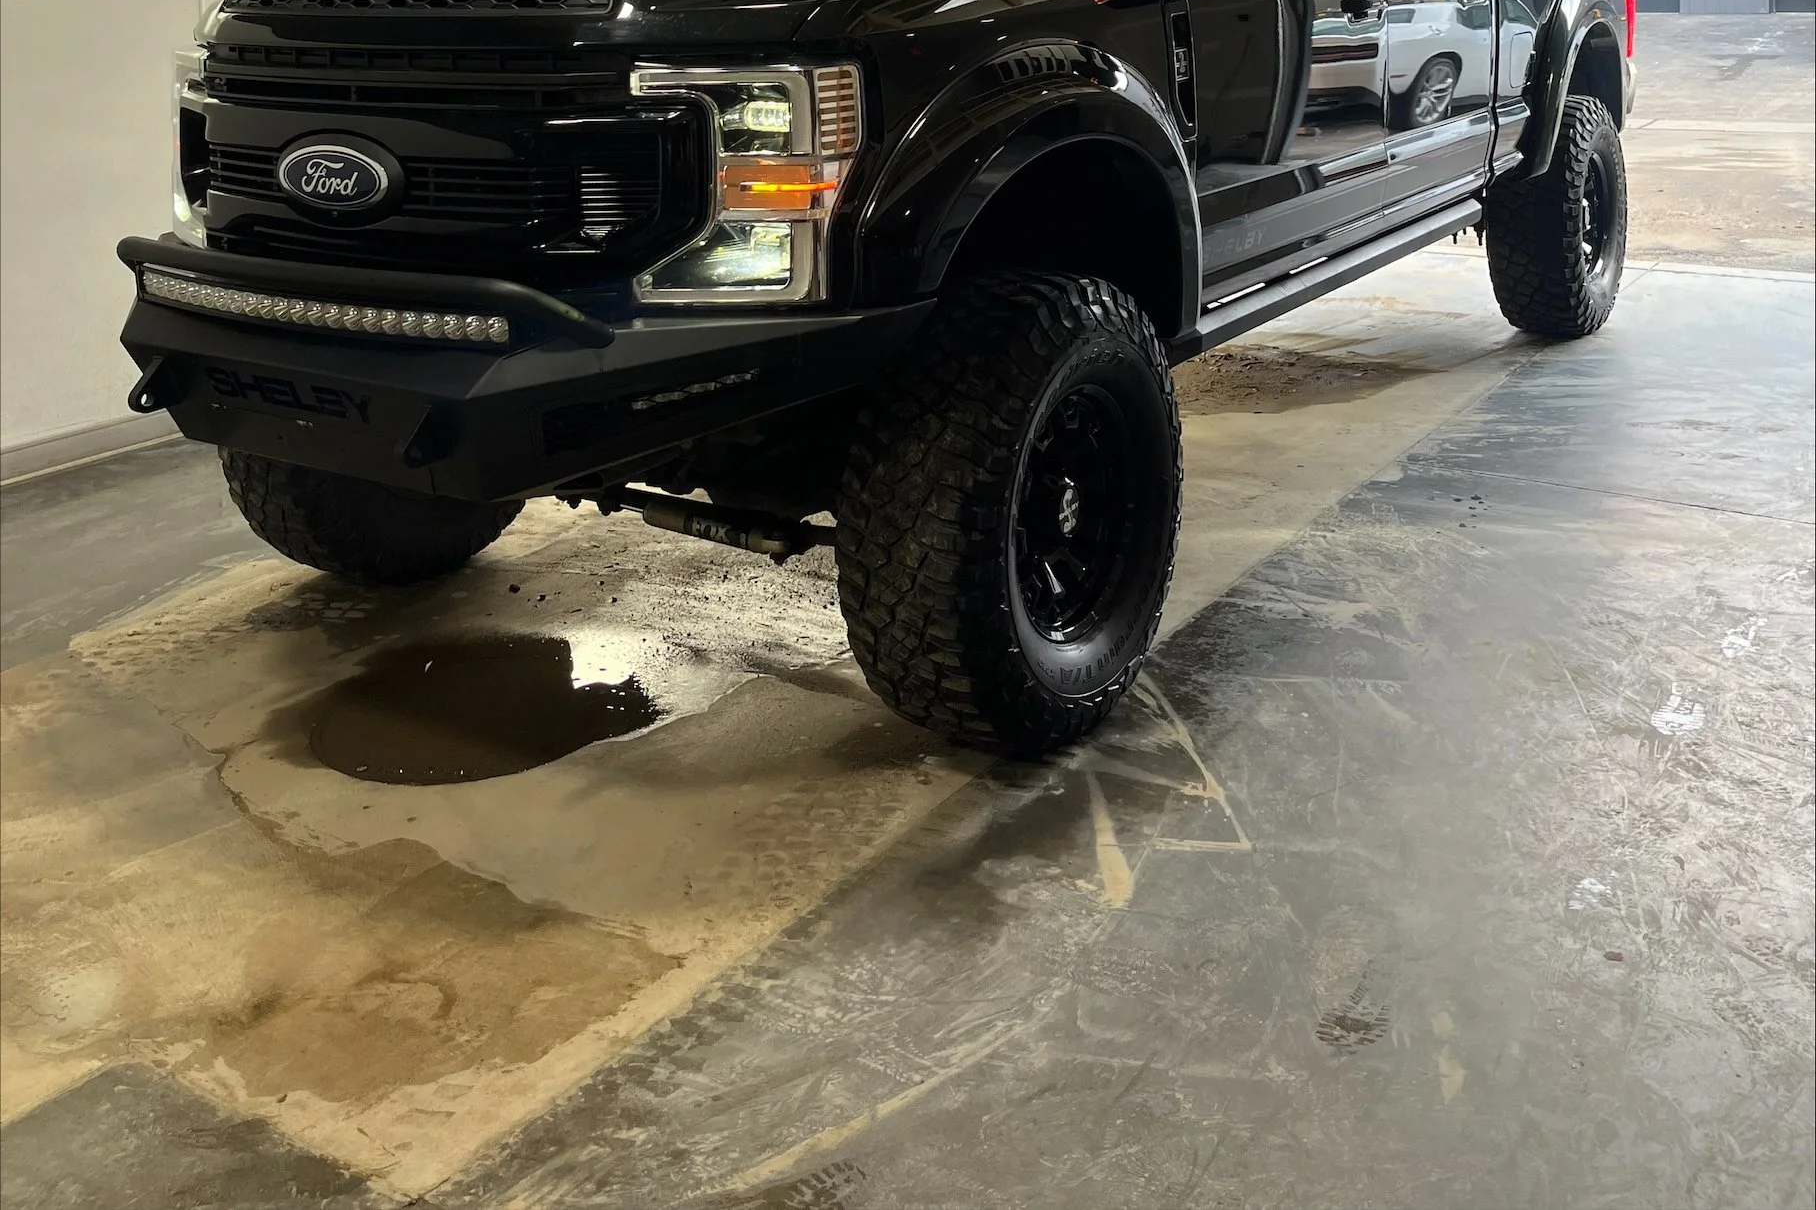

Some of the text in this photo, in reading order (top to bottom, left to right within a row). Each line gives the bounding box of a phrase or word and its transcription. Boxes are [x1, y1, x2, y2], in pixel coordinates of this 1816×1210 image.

[301, 158, 359, 196] Ford
[204, 365, 372, 425] SHELBY
[691, 516, 731, 544] FOX
